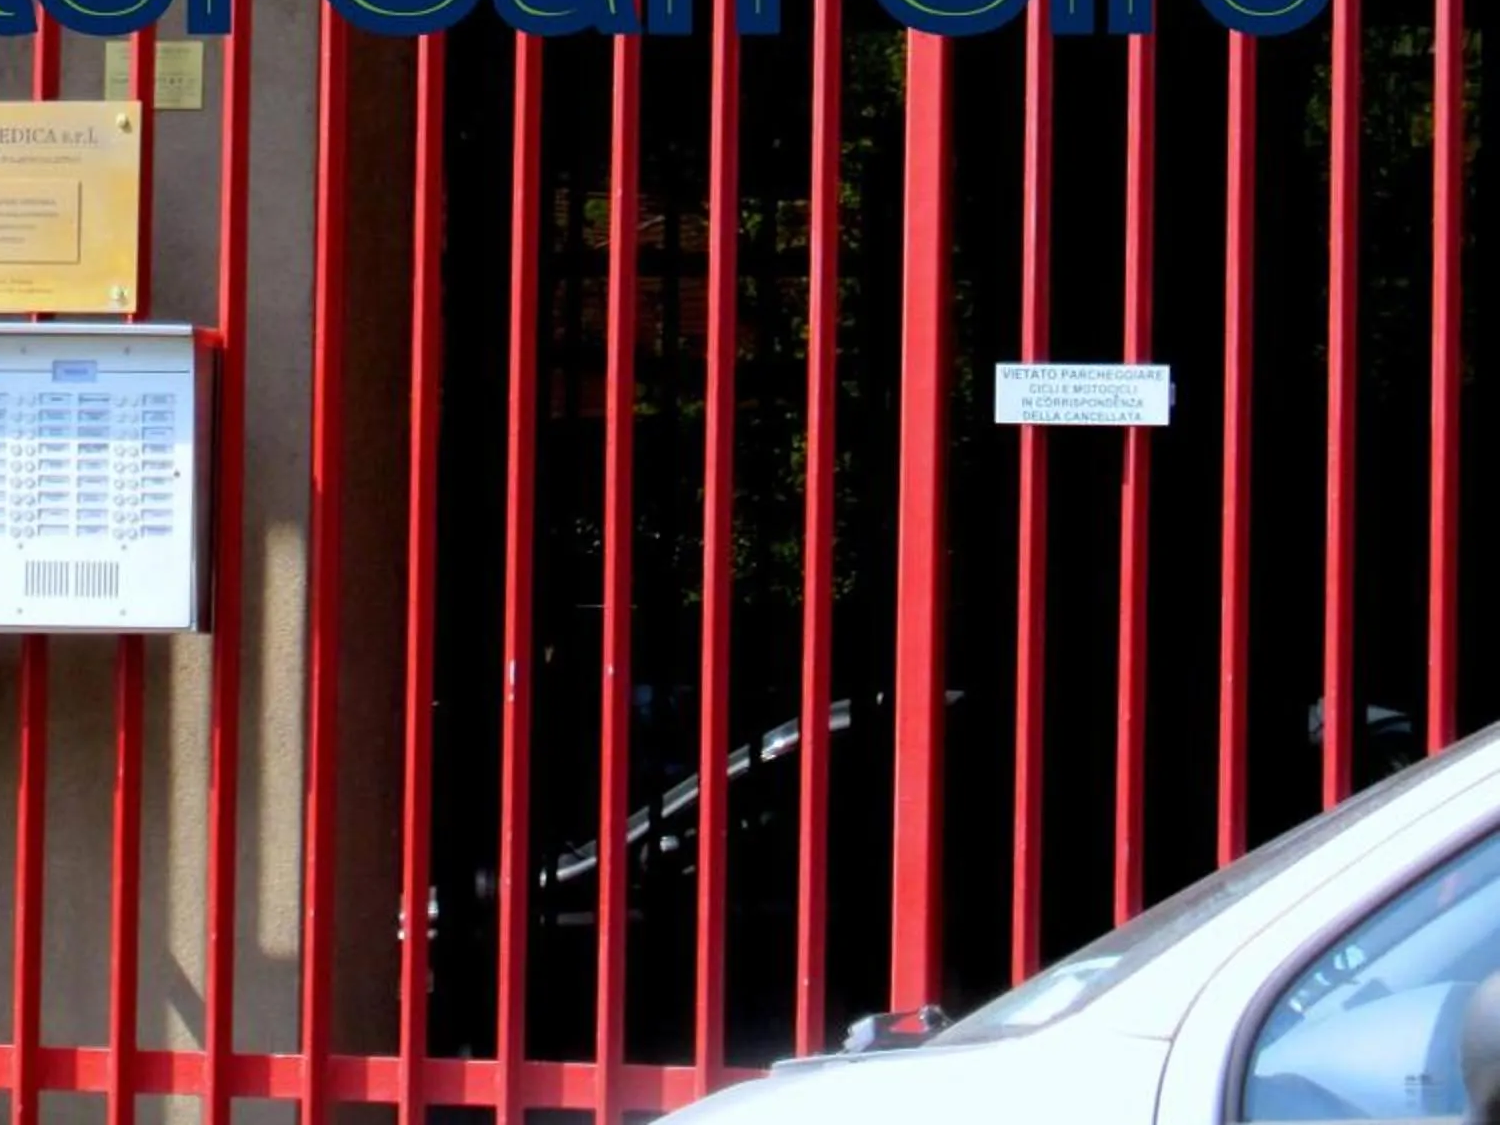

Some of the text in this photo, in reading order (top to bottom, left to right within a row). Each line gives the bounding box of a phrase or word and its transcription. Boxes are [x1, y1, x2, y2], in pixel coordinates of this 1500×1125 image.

[1002, 368, 1164, 381] VIETATO PARCHEGGIARE
[1072, 383, 1138, 395] MOTOCICLI
[1021, 396, 1144, 408] IN CORRISPONDENZA
[1022, 410, 1142, 422] DELLA CANCELLATA
